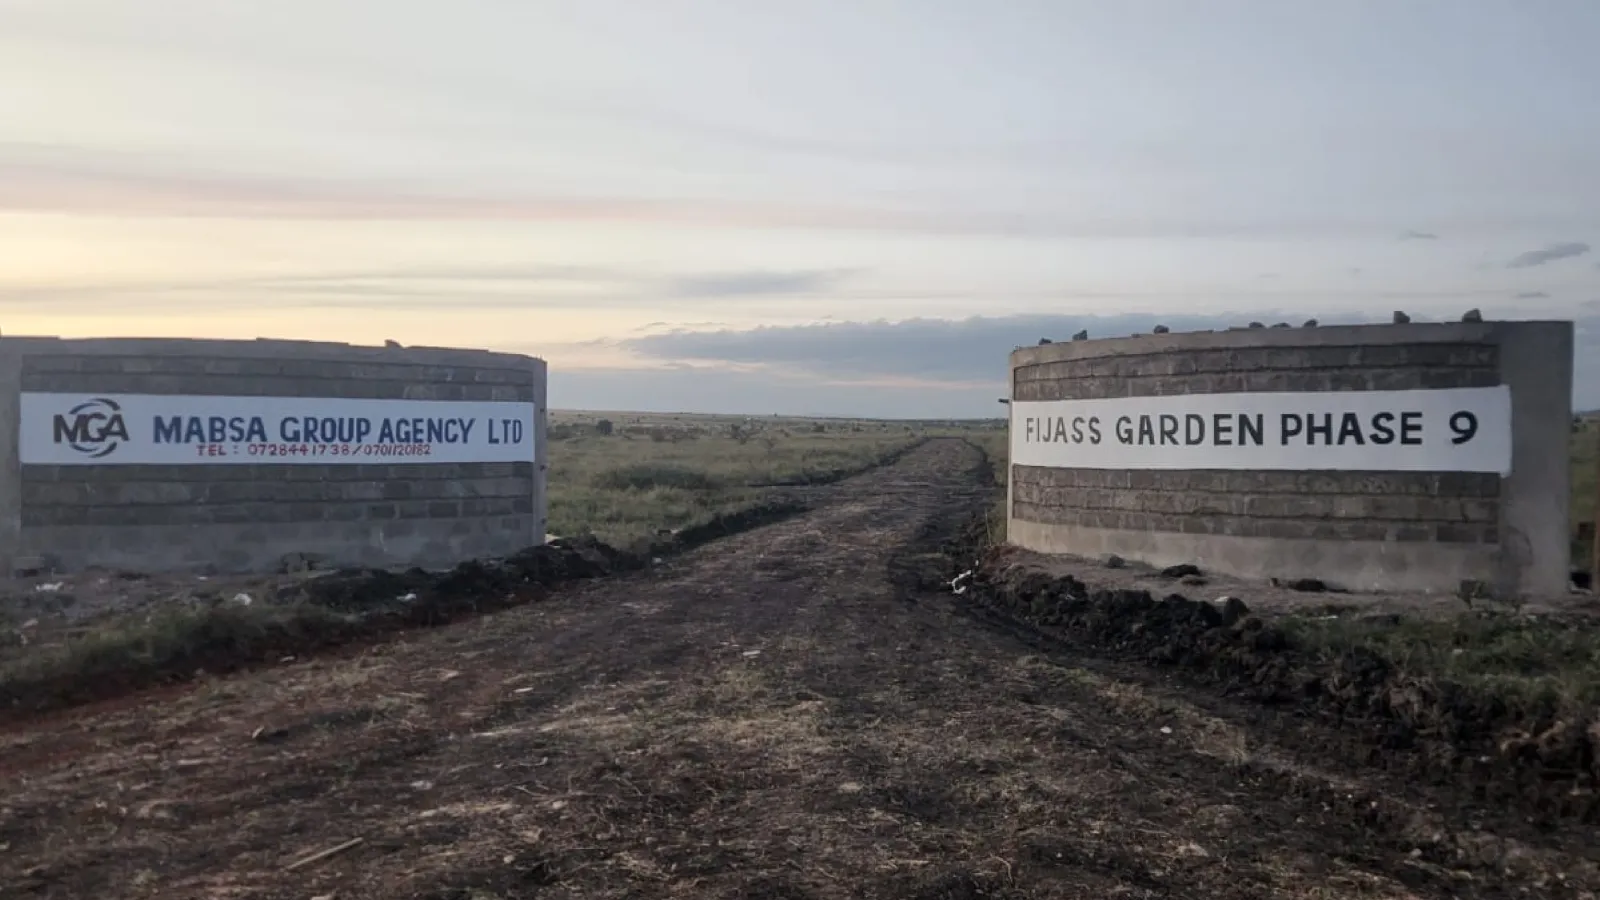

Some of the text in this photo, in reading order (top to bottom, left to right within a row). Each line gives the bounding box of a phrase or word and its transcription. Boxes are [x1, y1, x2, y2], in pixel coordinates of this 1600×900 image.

[53, 412, 130, 443] MGA
[153, 415, 523, 444] MABSA GROUP AGENCY LTD
[1026, 410, 1478, 446] FIJASS GARDEN PHASE 9
